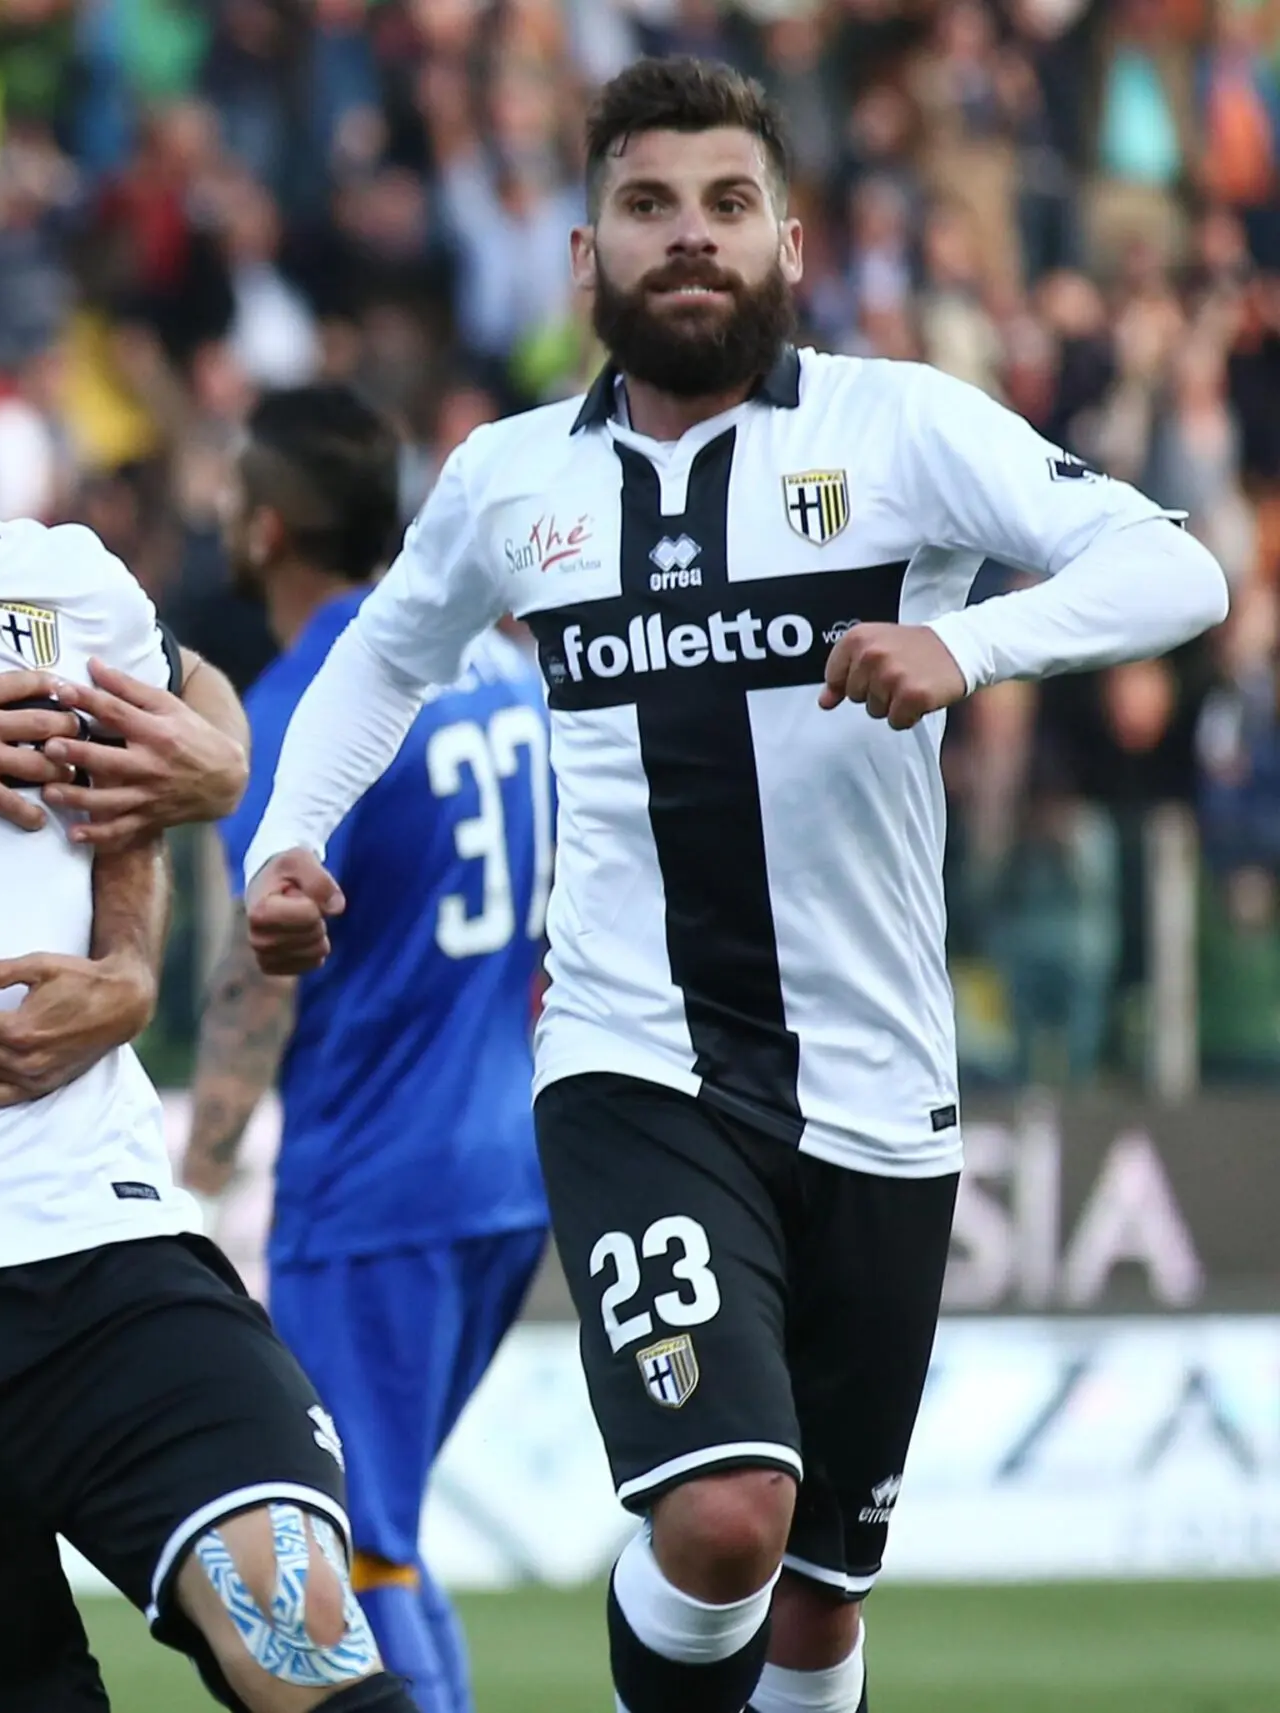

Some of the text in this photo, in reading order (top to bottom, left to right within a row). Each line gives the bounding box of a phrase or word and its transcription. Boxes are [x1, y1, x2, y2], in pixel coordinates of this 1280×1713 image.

[563, 609, 814, 682] folletto
[426, 706, 552, 960] 37
[589, 1215, 721, 1355] 23
